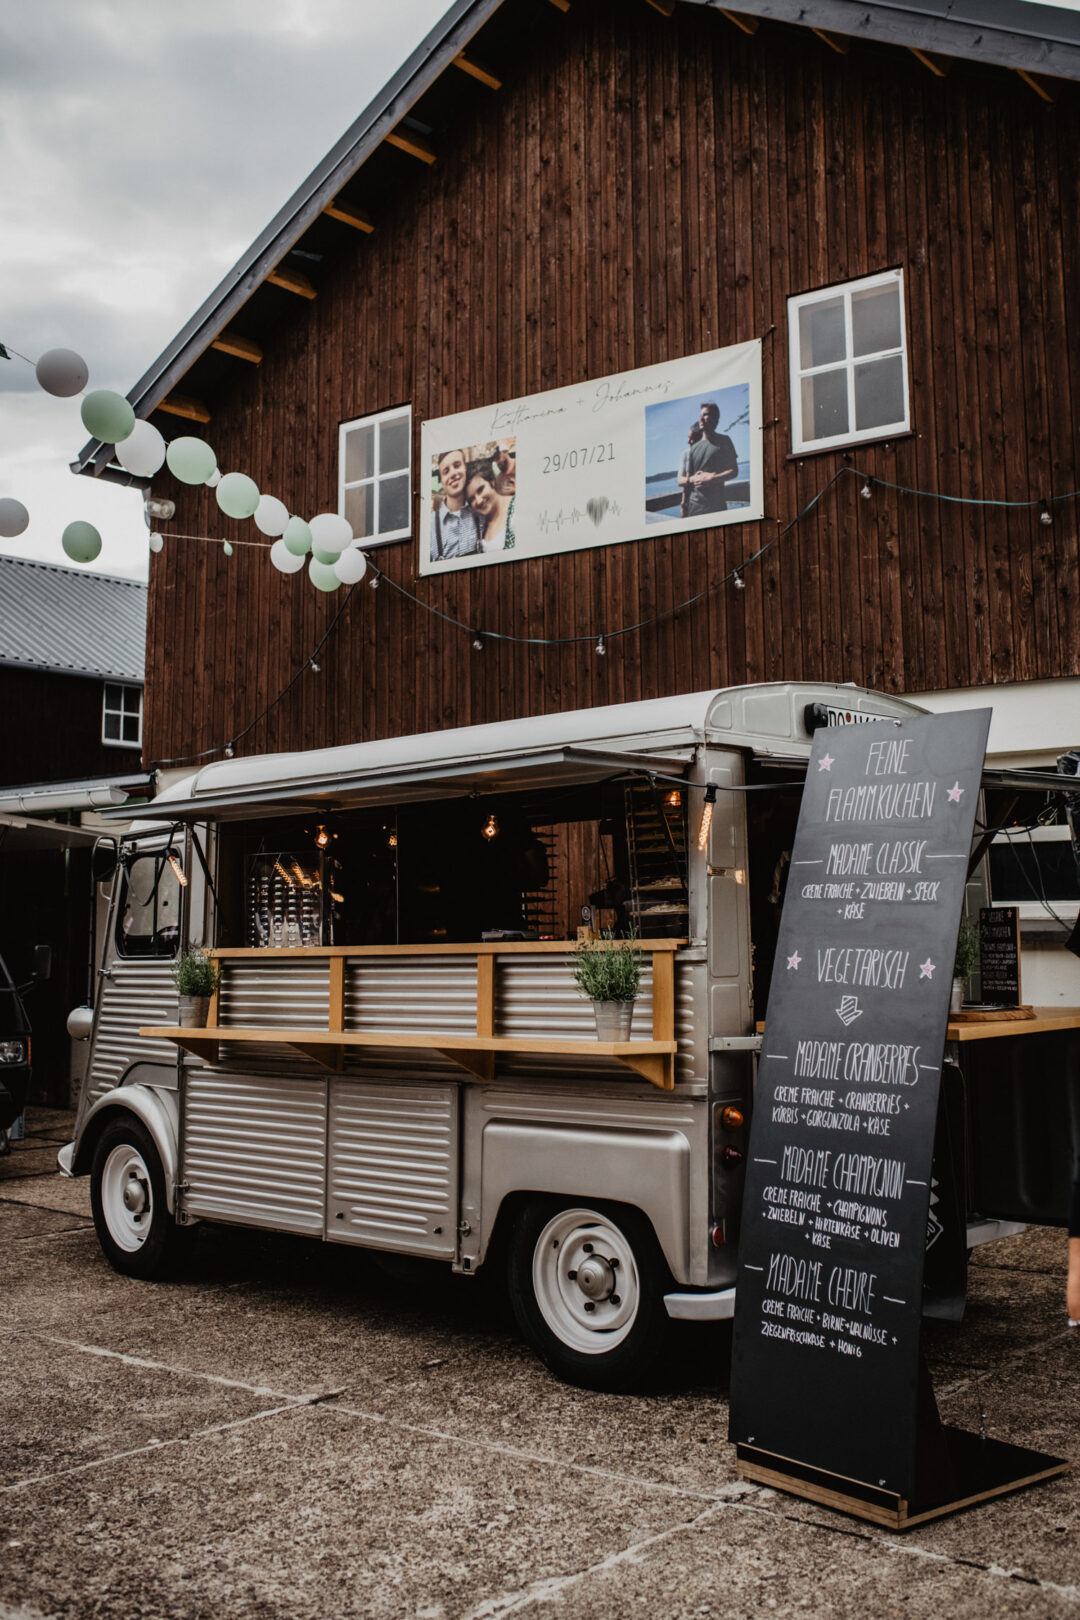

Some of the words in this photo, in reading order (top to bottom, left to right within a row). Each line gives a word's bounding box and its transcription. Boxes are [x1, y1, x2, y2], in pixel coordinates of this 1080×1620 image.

[543, 442, 615, 474] 29/07/21
[865, 739, 913, 775] FEINE
[826, 782, 936, 822] FLAMMKUCHEN
[826, 843, 874, 875] MADAME
[801, 883, 824, 899] CREME
[860, 881, 905, 901] ZWIEBELN
[911, 881, 940, 901] SPECK
[844, 902, 866, 920] KÄSE
[794, 1041, 845, 1081] MADAME
[844, 1042, 921, 1086] CRANBERRIES
[774, 1086, 800, 1104] CREME
[806, 1109, 860, 1132] GORGONZOLA
[867, 1116, 891, 1136] KÄSE
[781, 1145, 832, 1189] MADAME
[762, 1186, 788, 1205] CREME
[767, 1206, 805, 1226] ZWIEBELN
[870, 1228, 900, 1248] OLIVEN
[812, 1233, 832, 1250] KÄSE
[766, 1253, 823, 1302] MADAME
[828, 1266, 878, 1315] CHEVRE
[762, 1299, 785, 1317] CREME
[849, 1323, 888, 1346] WALNÜSSE
